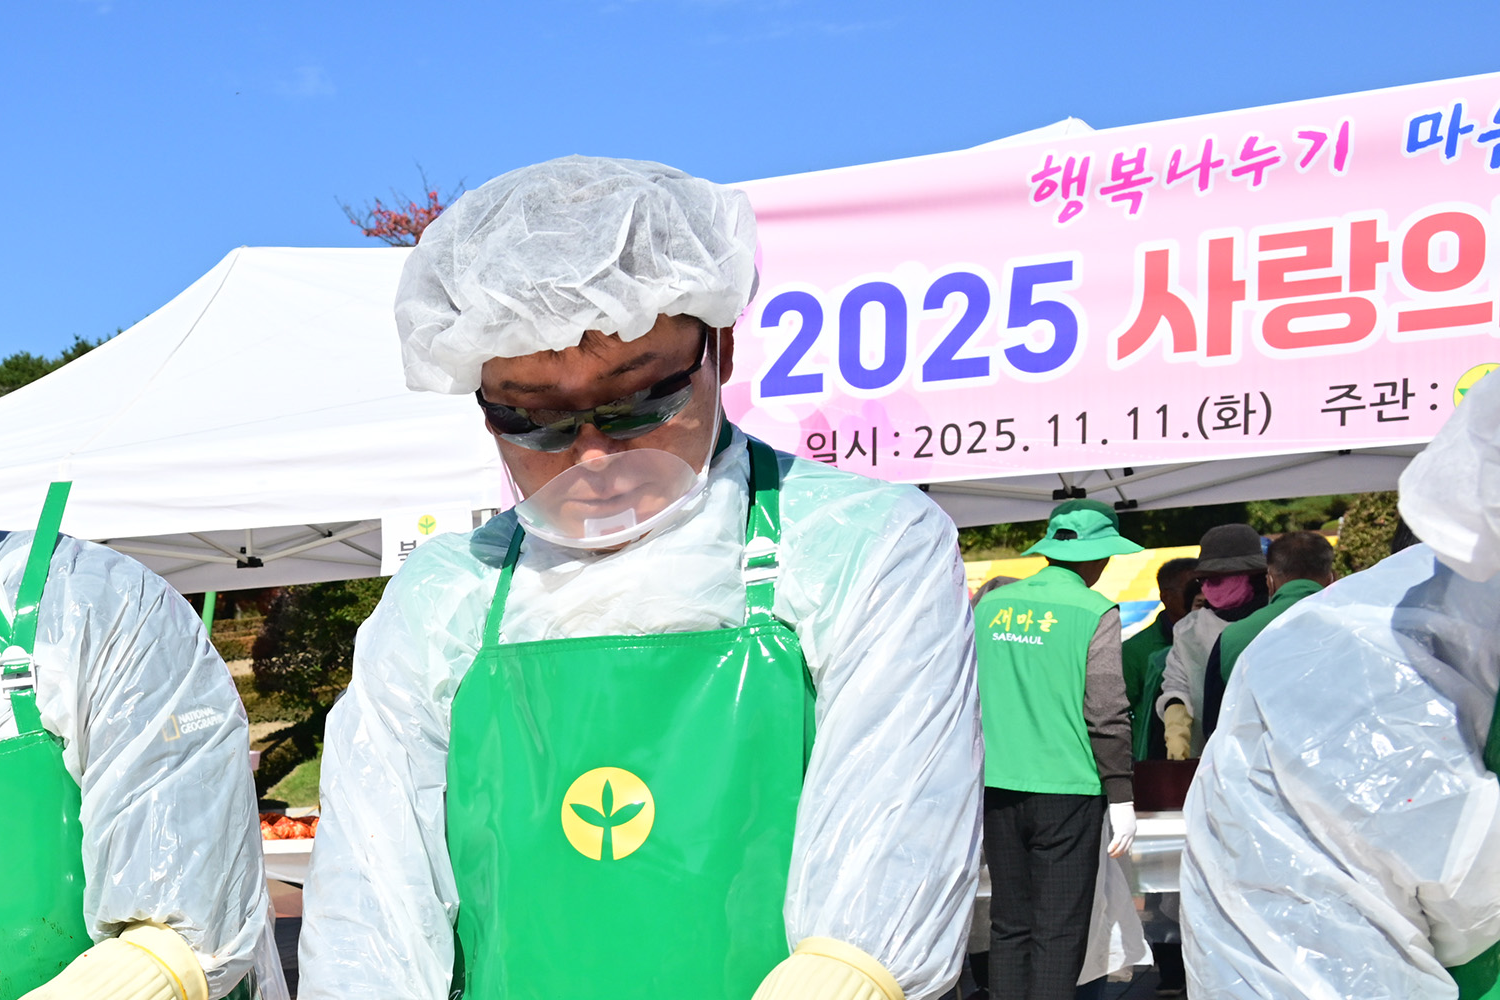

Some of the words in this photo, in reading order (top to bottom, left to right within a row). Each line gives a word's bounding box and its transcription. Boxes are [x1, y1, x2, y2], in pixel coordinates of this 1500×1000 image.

[1031, 120, 1349, 223] 행복나누기
[760, 260, 1078, 398] 2025
[988, 606, 1059, 633] 새마을
[991, 632, 1044, 645] SAEMAUL
